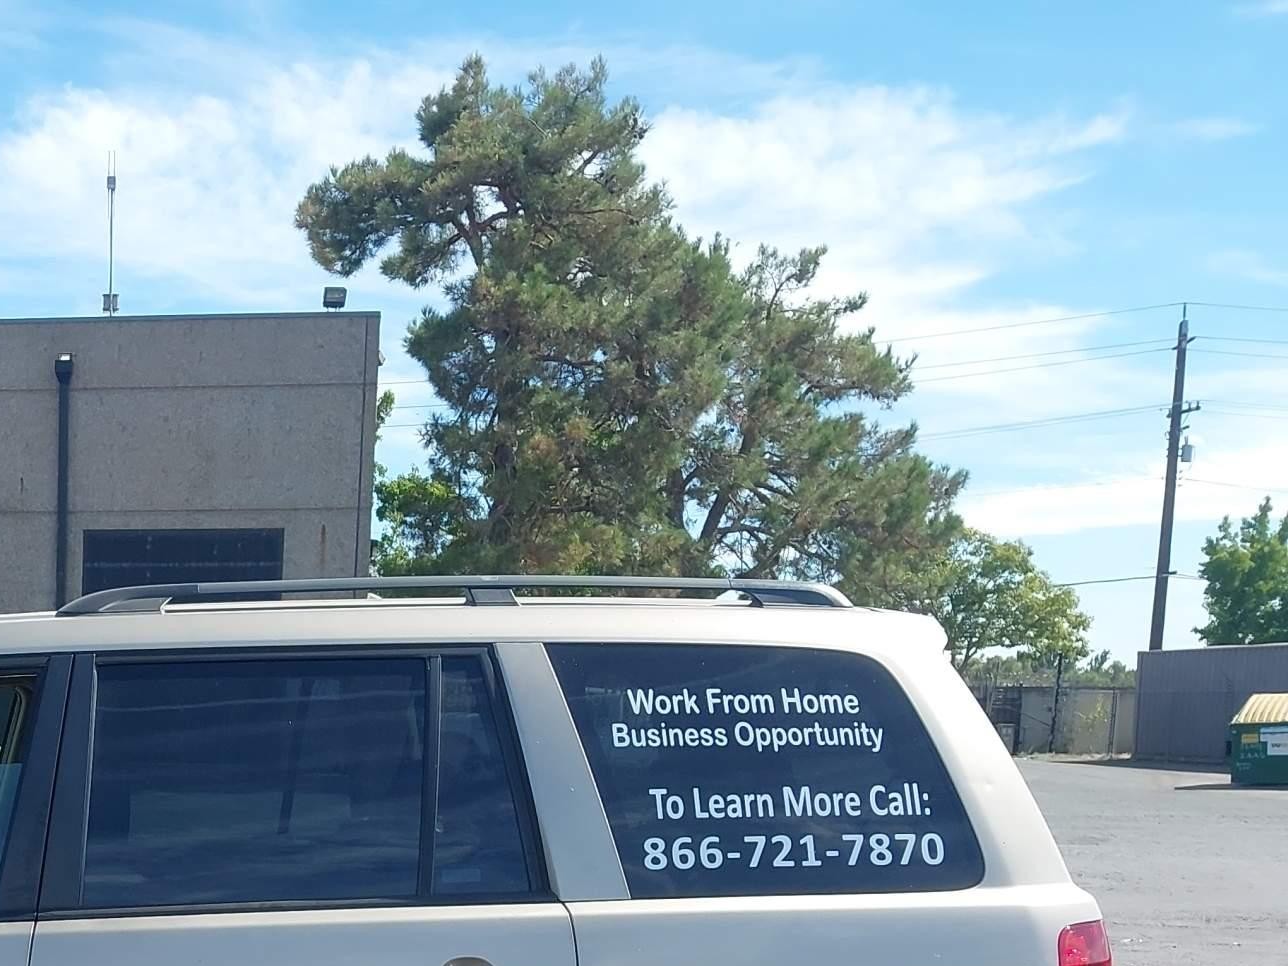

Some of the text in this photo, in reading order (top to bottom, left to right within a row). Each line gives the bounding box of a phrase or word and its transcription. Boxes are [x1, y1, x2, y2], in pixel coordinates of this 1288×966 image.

[626, 687, 860, 715] Work From Home
[611, 720, 884, 753] Business Opportunity
[648, 782, 932, 820] To Learn More Call:
[643, 832, 945, 870] 866-721-7870
